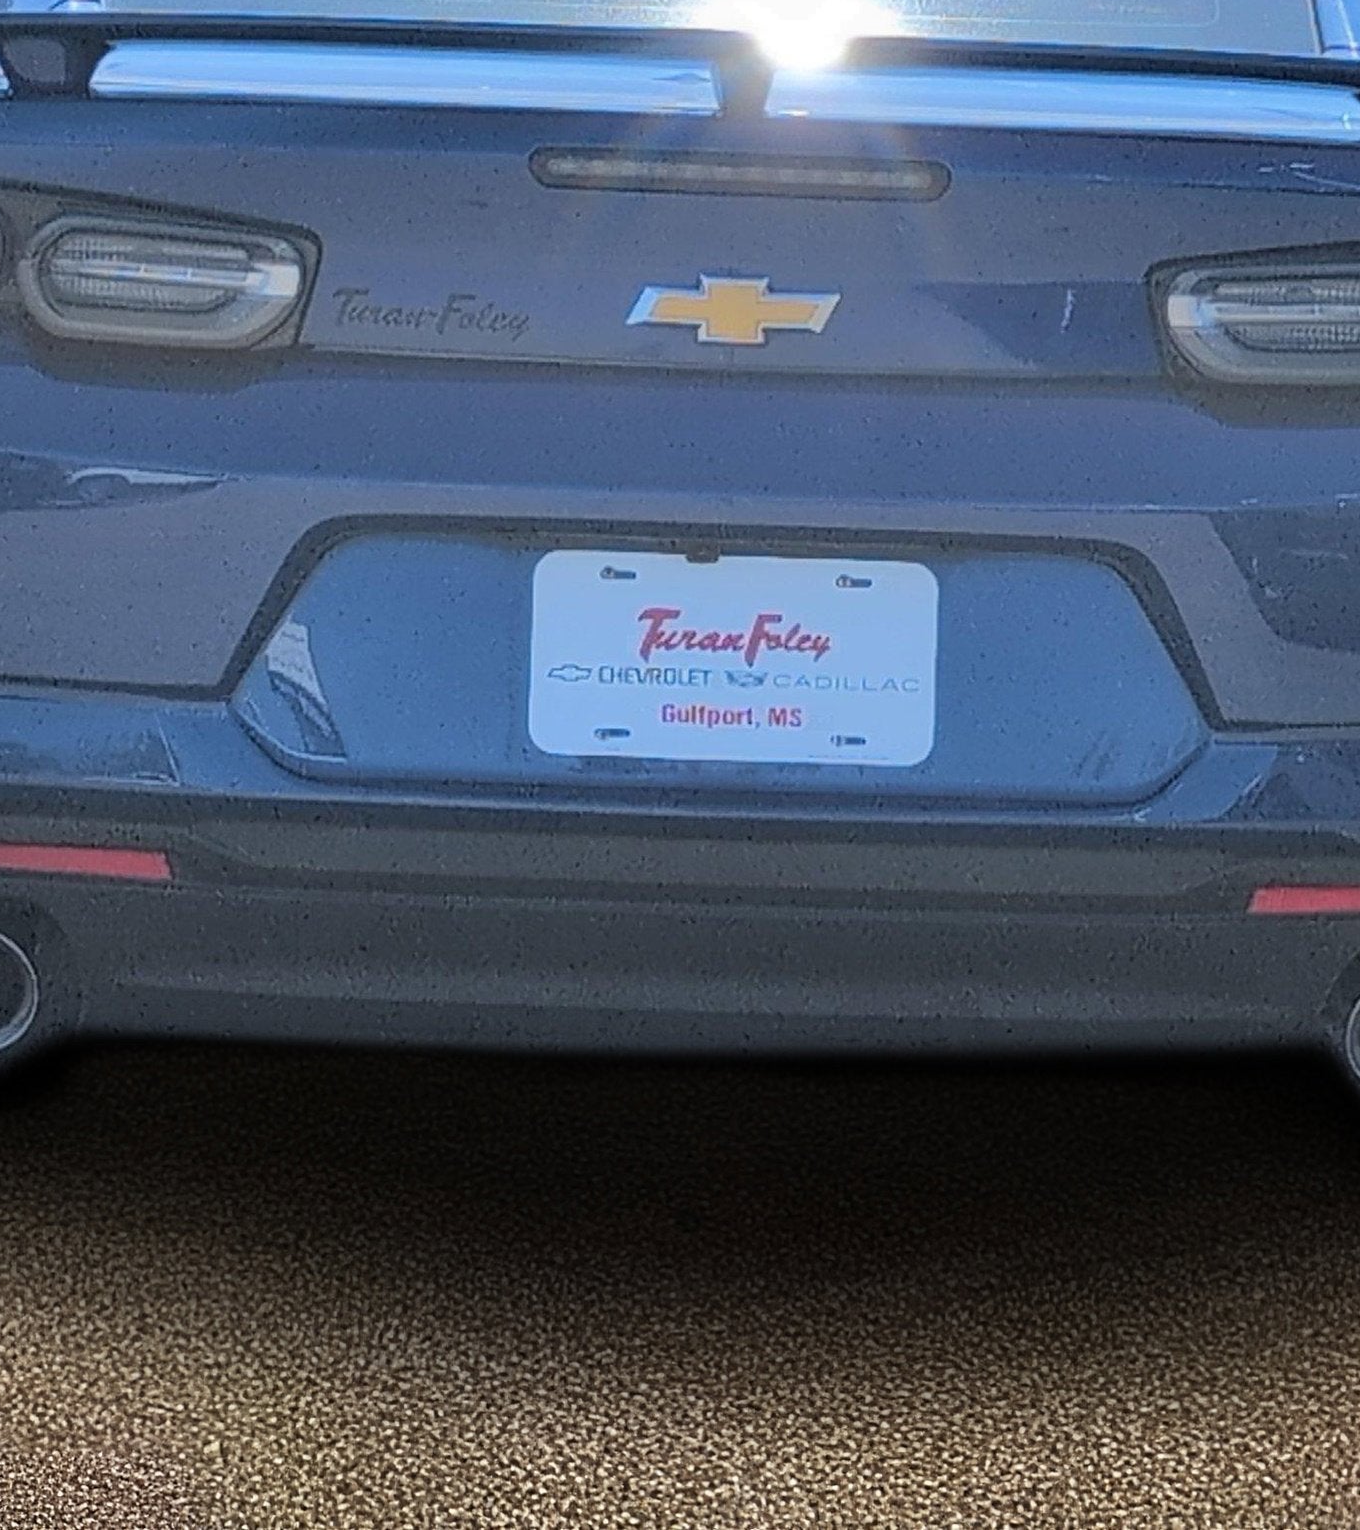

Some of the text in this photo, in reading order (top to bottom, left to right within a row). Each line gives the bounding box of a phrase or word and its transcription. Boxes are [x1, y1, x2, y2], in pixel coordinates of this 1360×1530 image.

[597, 664, 921, 693] CHEVROLET CADILLAC
[661, 703, 803, 730] Gulfport, MS
